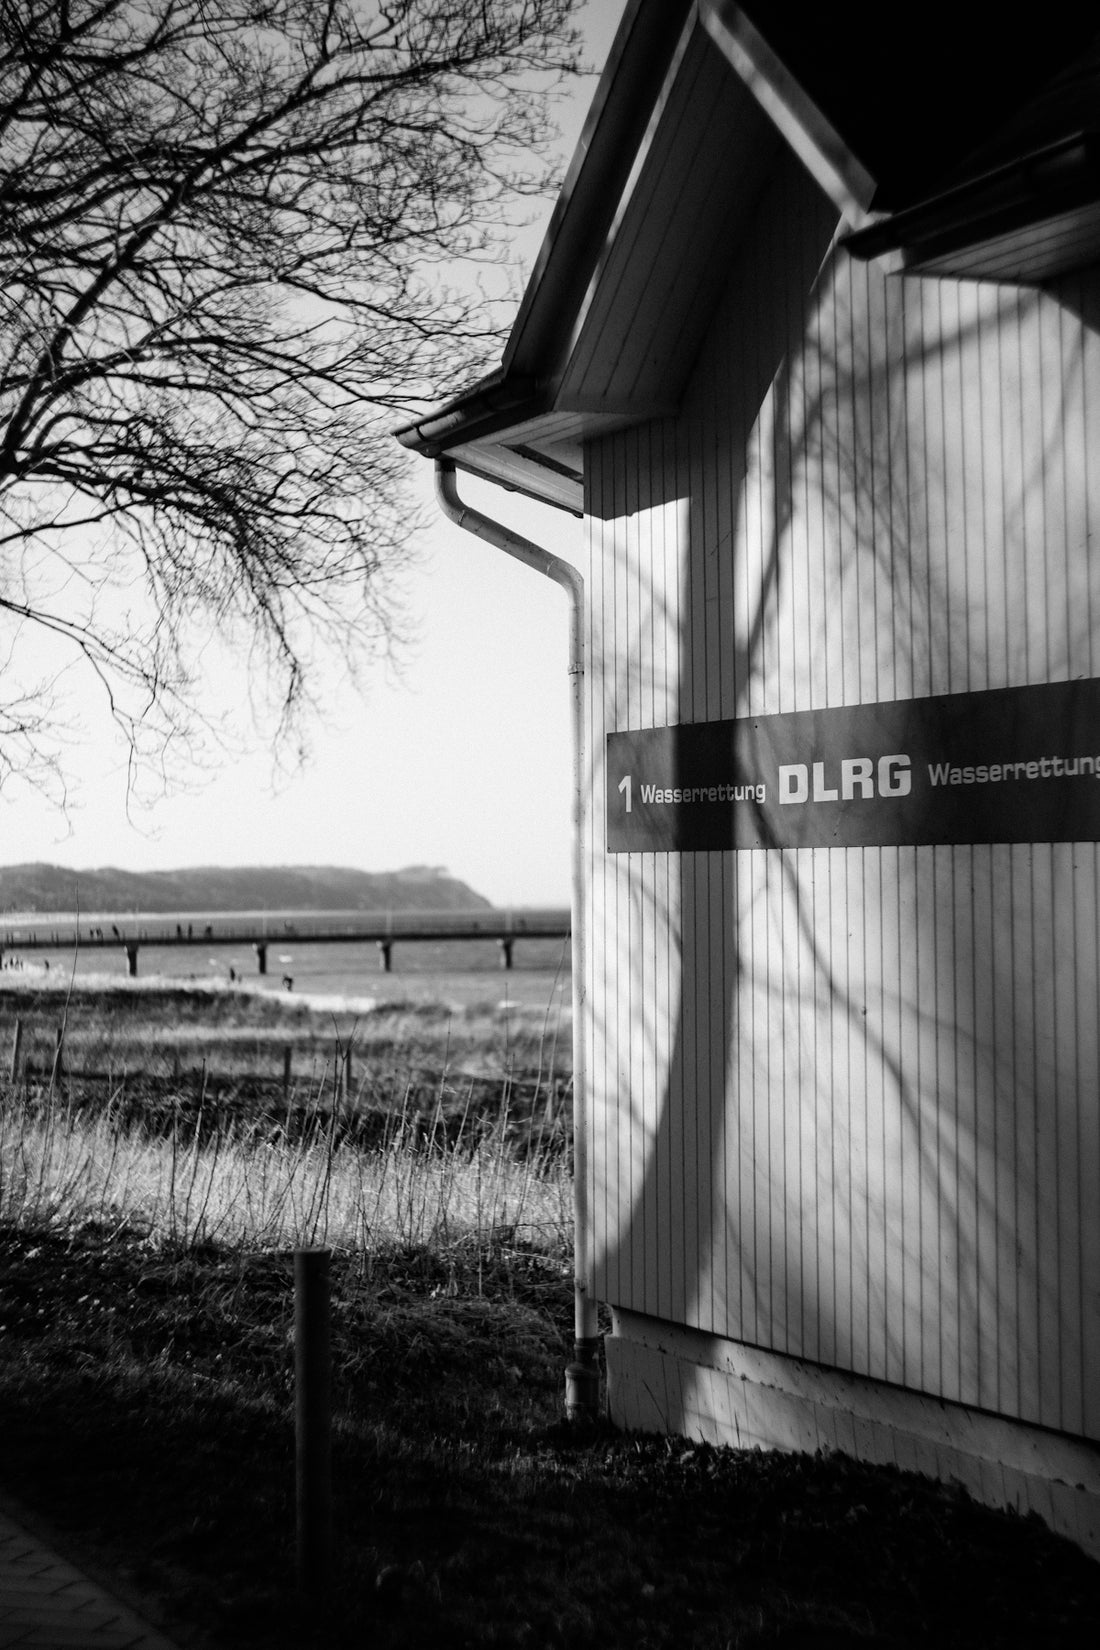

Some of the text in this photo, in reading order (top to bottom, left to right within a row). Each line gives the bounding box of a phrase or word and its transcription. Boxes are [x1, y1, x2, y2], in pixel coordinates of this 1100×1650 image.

[617, 775, 632, 813] 1
[640, 783, 766, 804] Wasserrettung
[779, 754, 911, 804] DLRG
